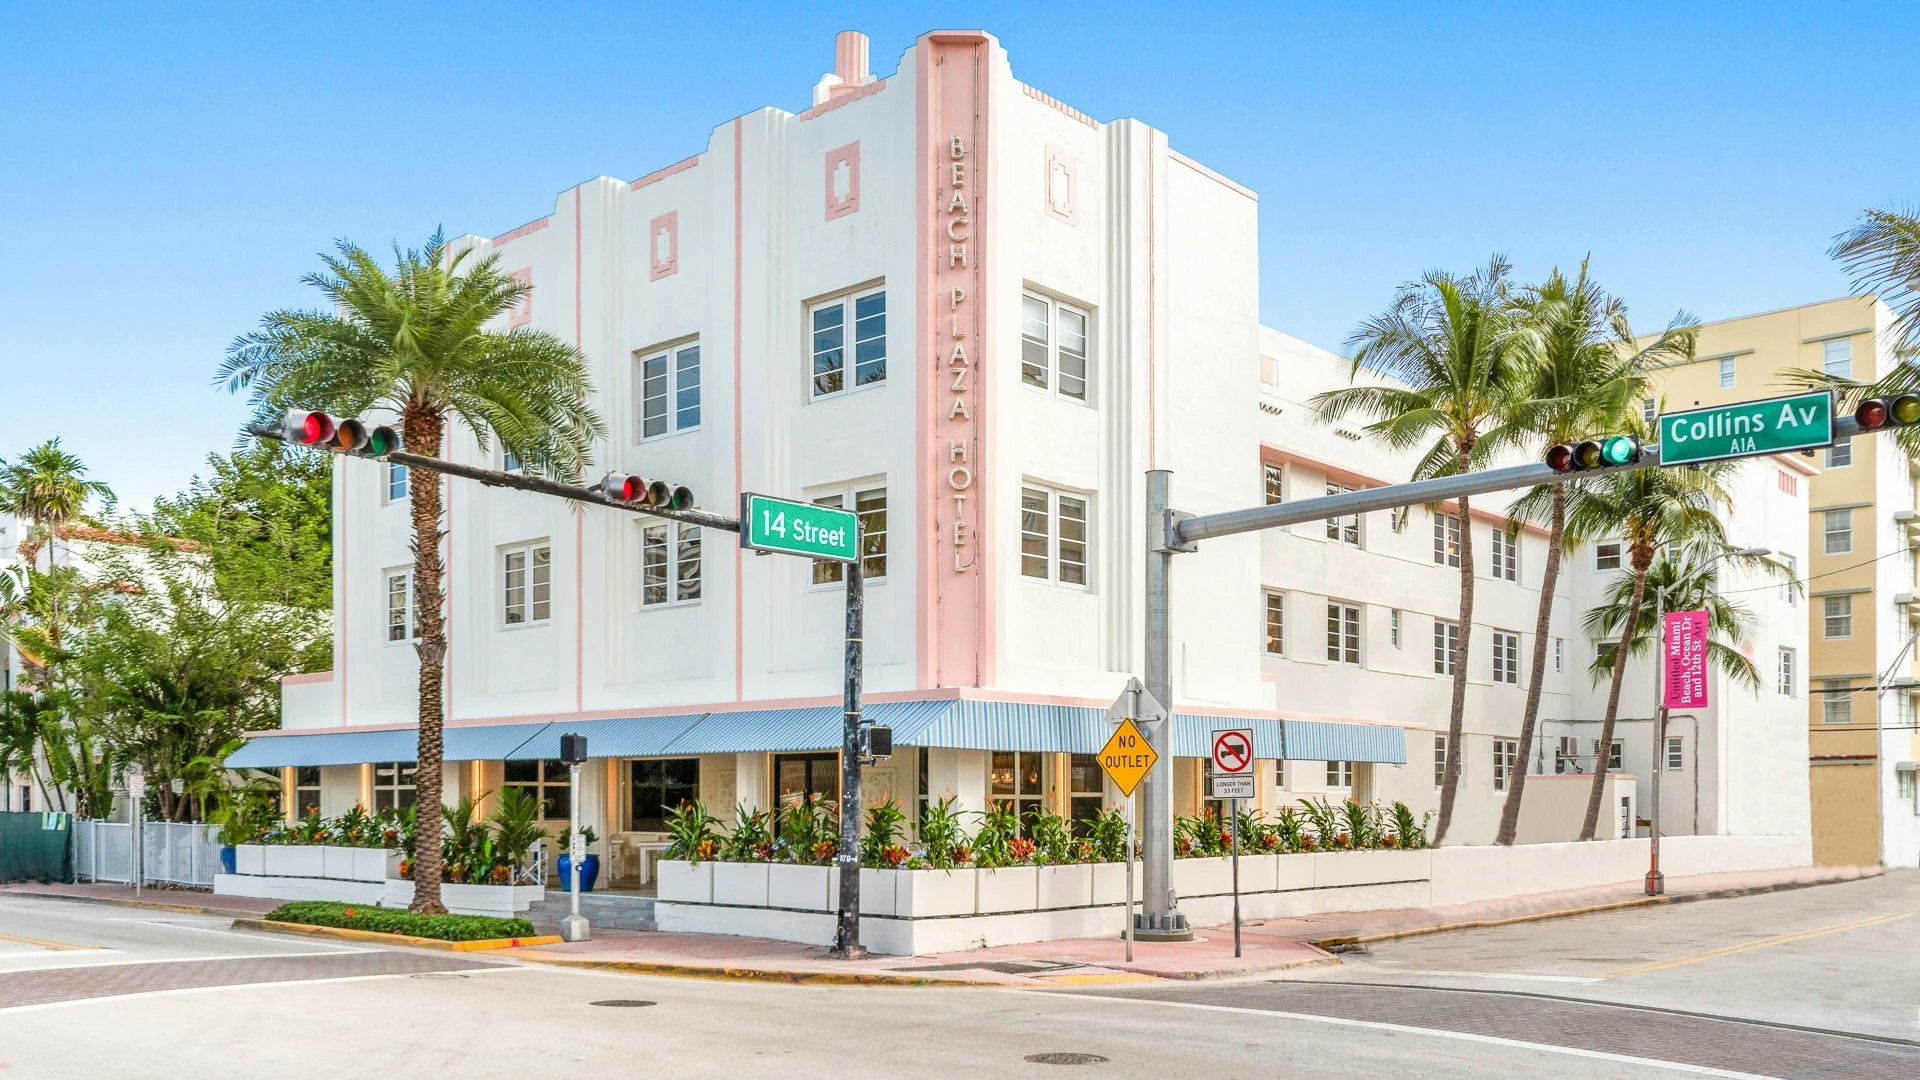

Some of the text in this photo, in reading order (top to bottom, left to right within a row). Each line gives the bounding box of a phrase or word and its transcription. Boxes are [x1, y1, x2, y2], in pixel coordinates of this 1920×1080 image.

[947, 134, 972, 572] BEACH PLAZA HOTEL
[1671, 403, 1818, 443] Collins Av
[1730, 436, 1756, 454] A1A
[763, 509, 846, 548] 14 Street
[1670, 621, 1681, 700] Untitled Miami
[1681, 616, 1692, 704] Beach, Ocean Dr
[1691, 621, 1703, 698] and 12th St Art
[1105, 755, 1150, 768] OUTLET
[1118, 735, 1136, 748] NO
